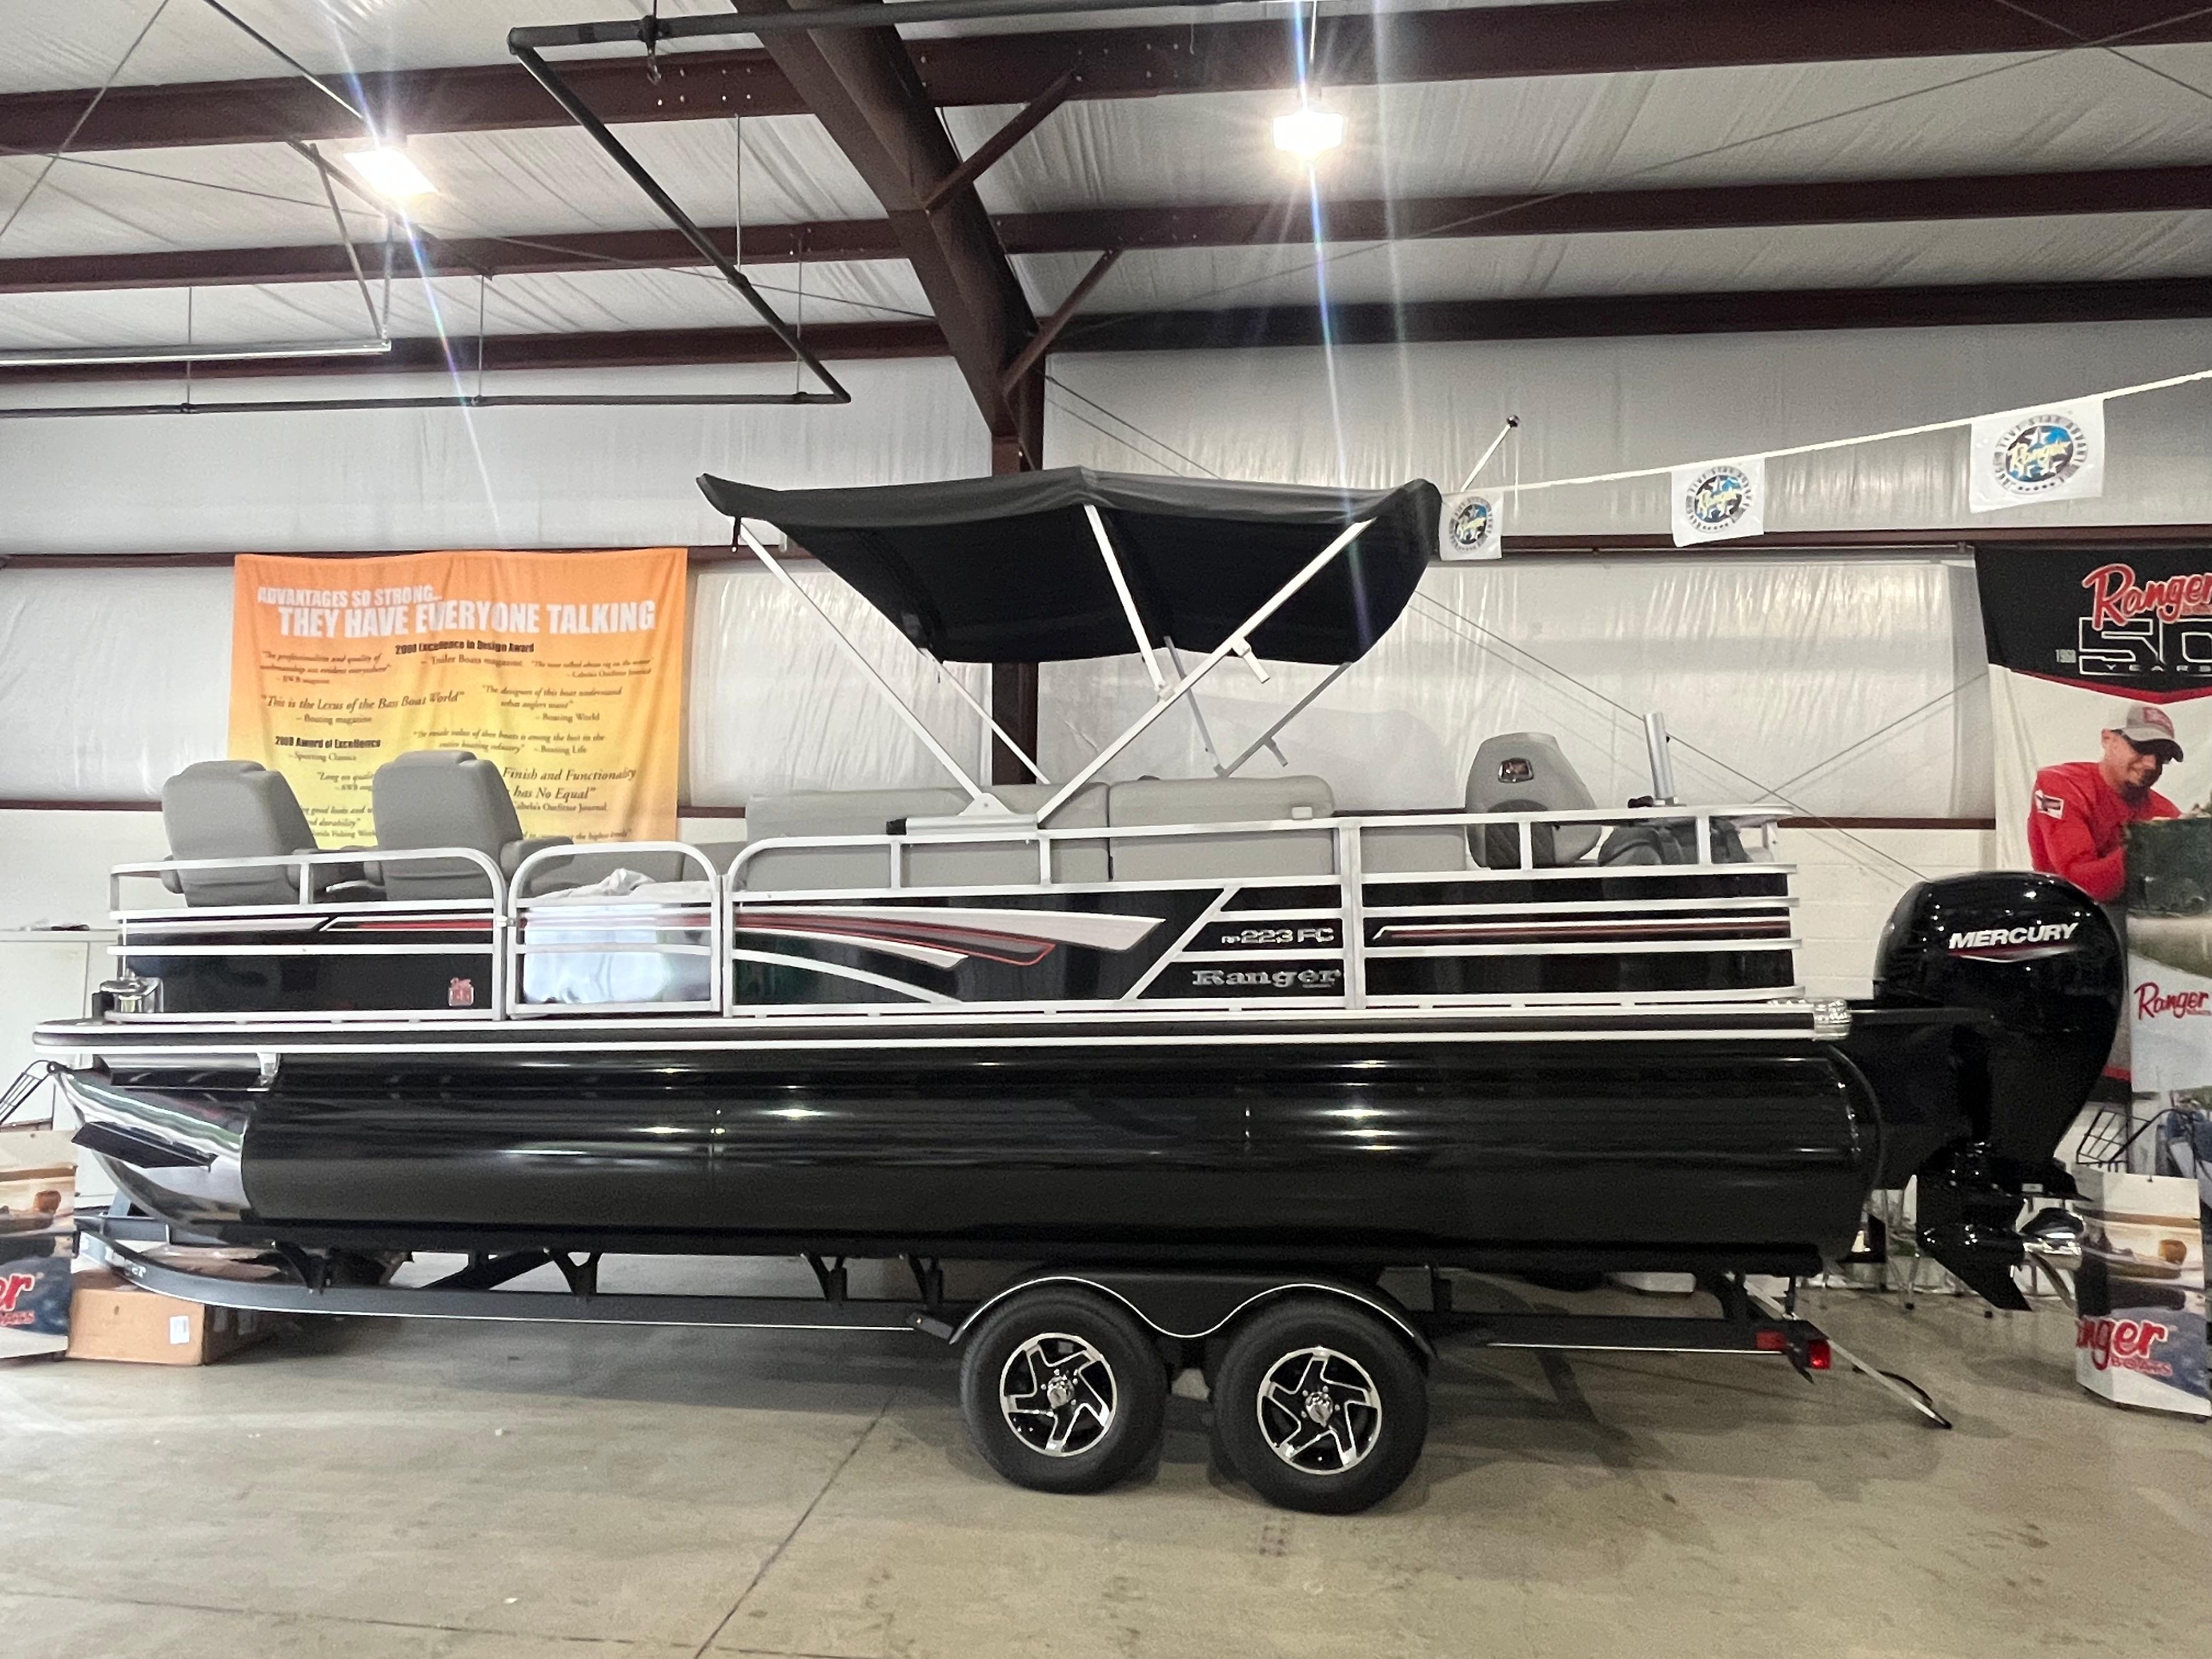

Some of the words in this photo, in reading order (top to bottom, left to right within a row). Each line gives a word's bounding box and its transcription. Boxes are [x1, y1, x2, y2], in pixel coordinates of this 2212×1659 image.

[257, 586, 348, 608] ADVANTAGES
[352, 590, 371, 607] SO
[278, 606, 340, 639] THEY
[344, 605, 409, 638] HAVE
[415, 599, 540, 634] EVERYONE
[546, 600, 657, 635] TALKING
[419, 641, 465, 652] Excellence
[466, 640, 476, 650] in
[477, 640, 507, 653] Design
[508, 643, 535, 653] Award
[288, 697, 296, 708] is
[299, 698, 314, 709] the
[317, 699, 343, 710] Lexus
[346, 698, 359, 713] of
[359, 698, 375, 710] the
[377, 698, 398, 709] Bass
[295, 737, 323, 748] Award
[334, 739, 381, 748] Excellence
[502, 767, 538, 781] Finish
[540, 769, 563, 781] and
[565, 767, 636, 782] Functionality
[513, 785, 533, 798] has
[535, 787, 552, 799] No
[1297, 927, 1335, 943] FC
[1948, 922, 2079, 950] MERCURY
[1192, 969, 1342, 988] Ranger
[2133, 981, 2209, 1020] Ranger
